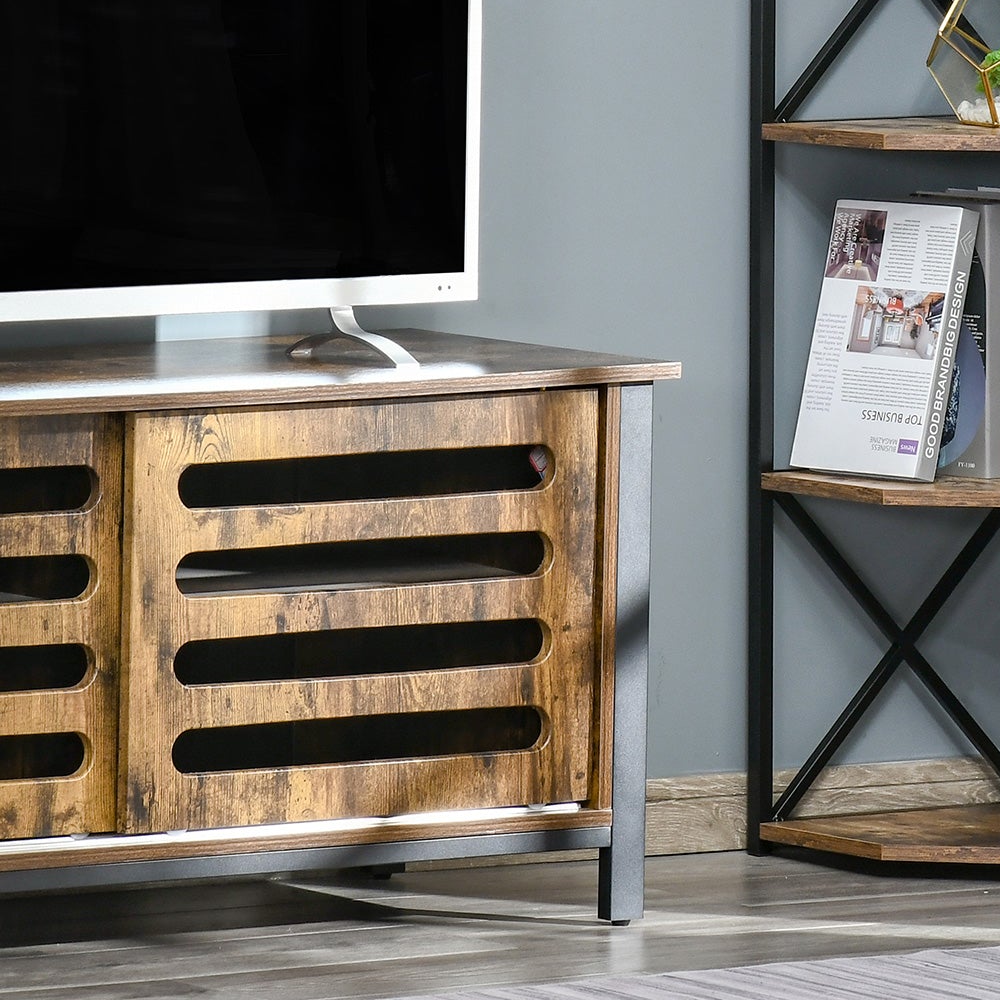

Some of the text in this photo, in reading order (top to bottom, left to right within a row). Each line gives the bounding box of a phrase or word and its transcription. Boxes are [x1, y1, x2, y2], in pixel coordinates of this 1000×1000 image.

[925, 413, 941, 458] GOOD
[948, 271, 967, 330] DESIGN
[861, 410, 922, 425] TOP BUSINESS
